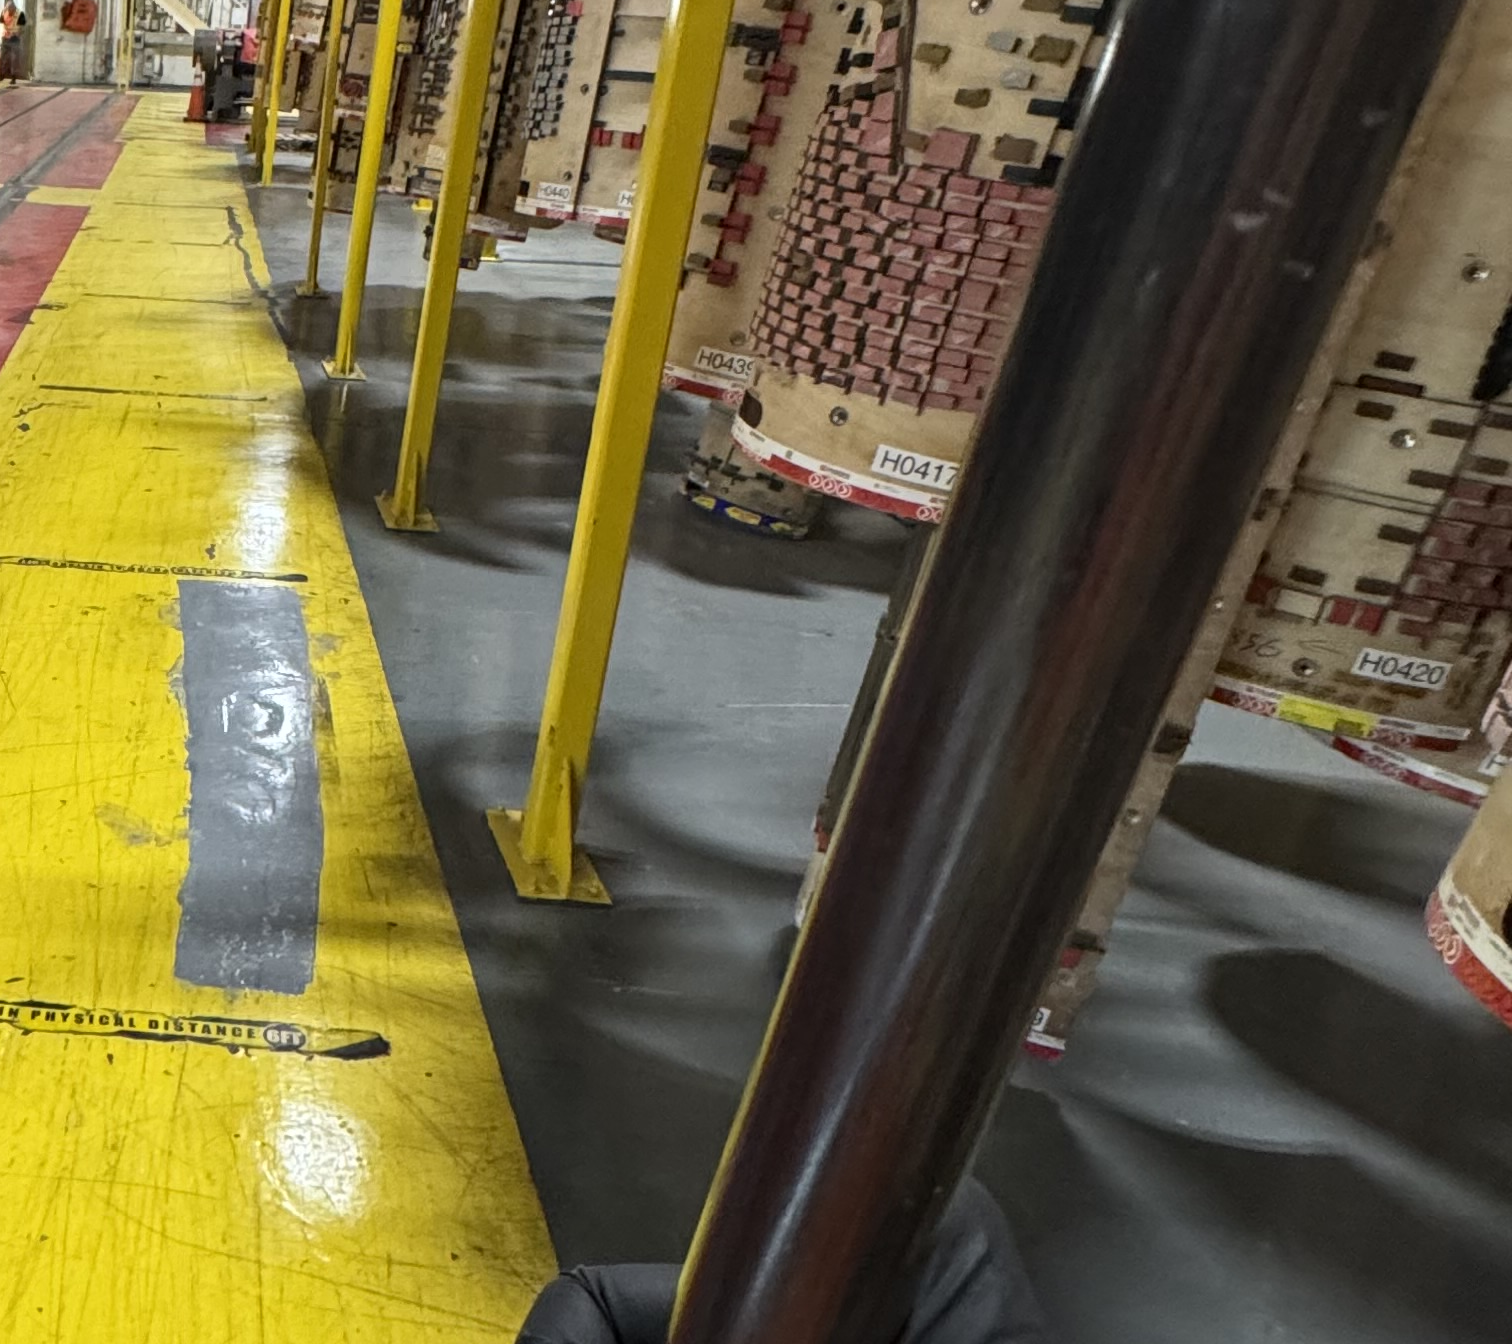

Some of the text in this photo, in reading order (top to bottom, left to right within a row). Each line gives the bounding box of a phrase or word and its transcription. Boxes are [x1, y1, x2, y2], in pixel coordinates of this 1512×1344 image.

[880, 450, 960, 485] H0417
[1358, 652, 1446, 685] H0420
[31, 1010, 137, 1029] PHYSICAL
[148, 1018, 256, 1039] DISTANCE
[266, 1030, 303, 1045] 6FT
